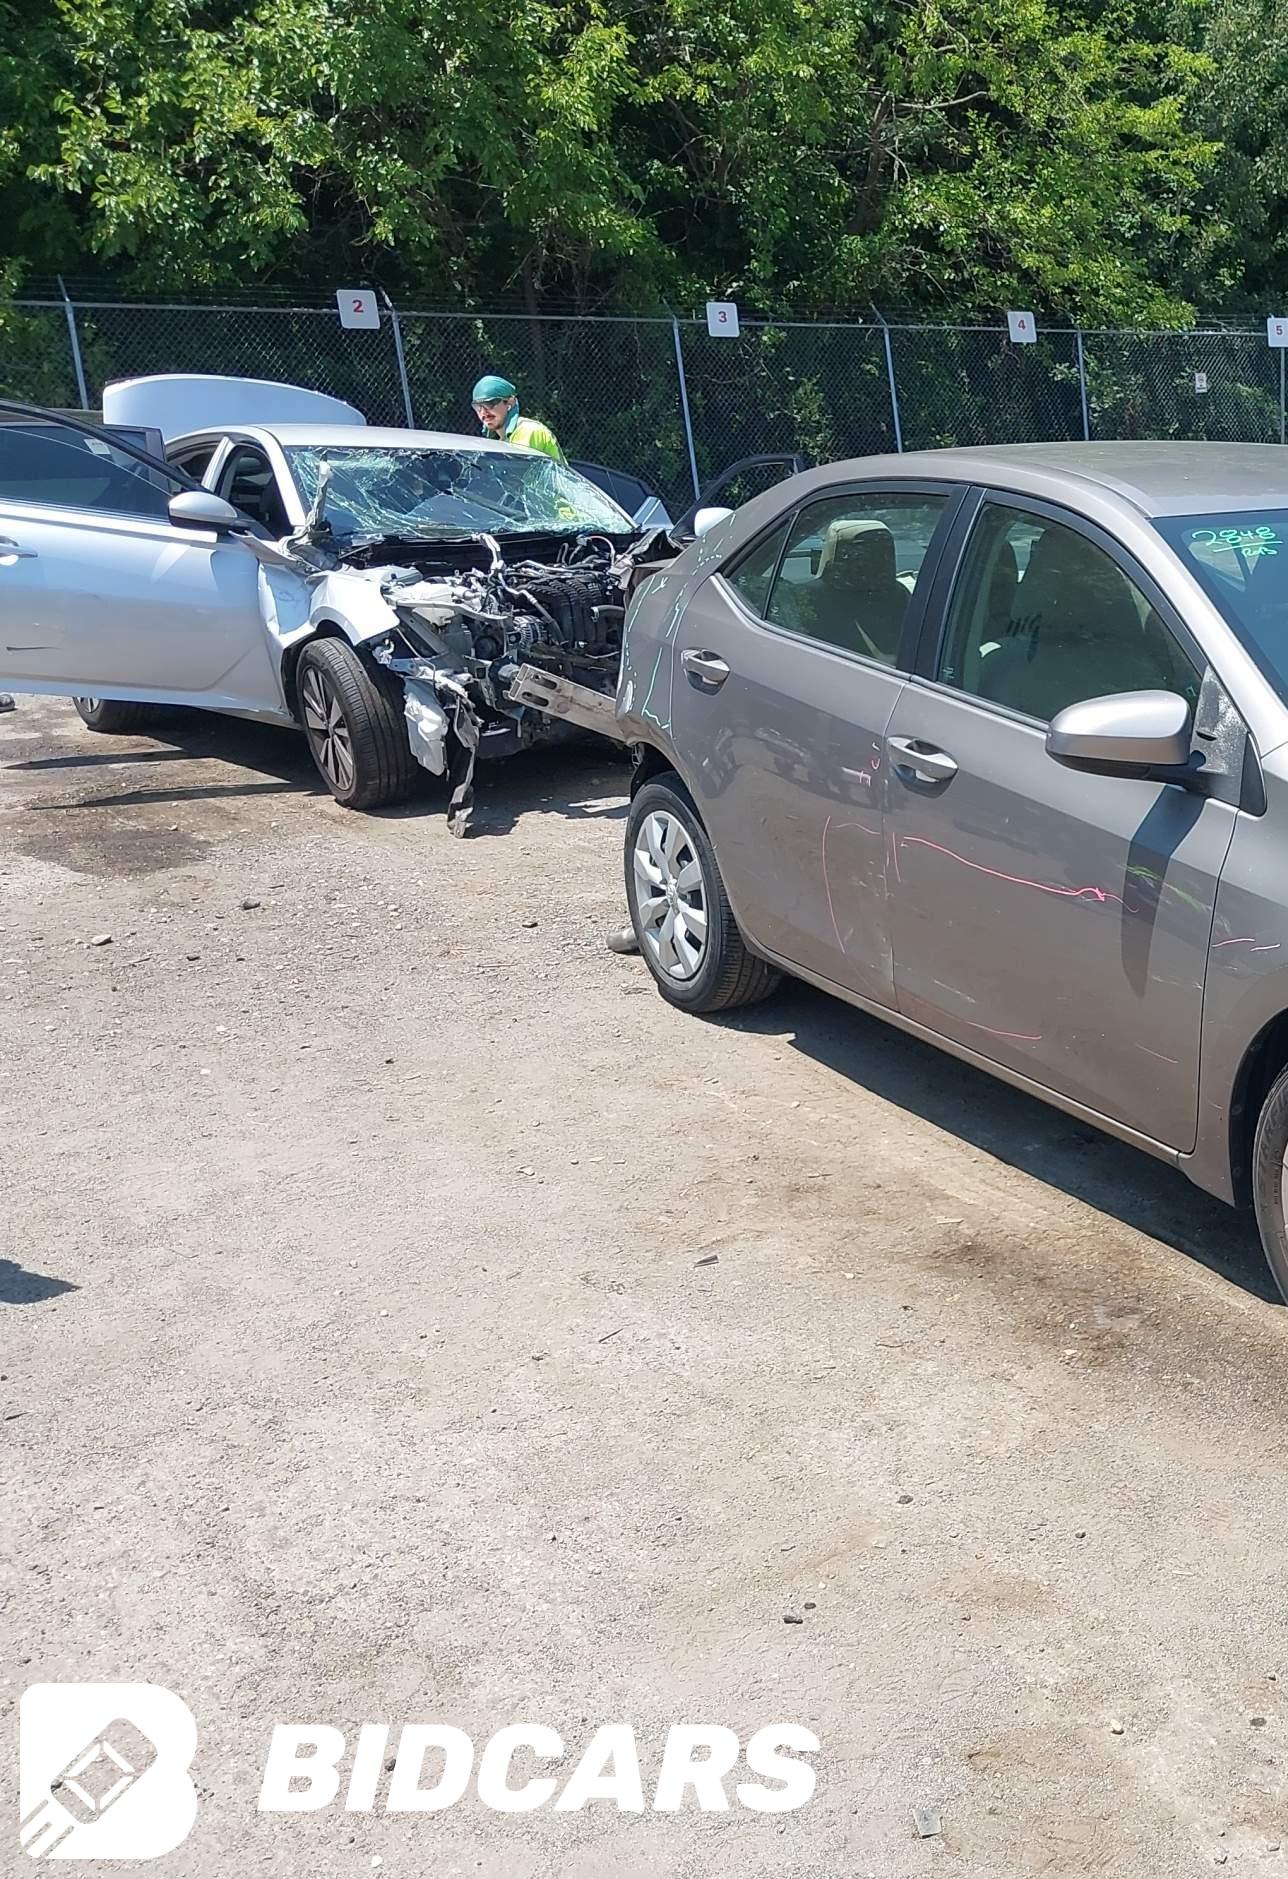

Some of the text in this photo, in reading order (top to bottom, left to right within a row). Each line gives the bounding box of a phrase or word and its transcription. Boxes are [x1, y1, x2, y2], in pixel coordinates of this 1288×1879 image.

[352, 299, 364, 312] 2
[718, 311, 728, 323] 3
[1018, 319, 1026, 330] 4
[1276, 325, 1283, 335] 5
